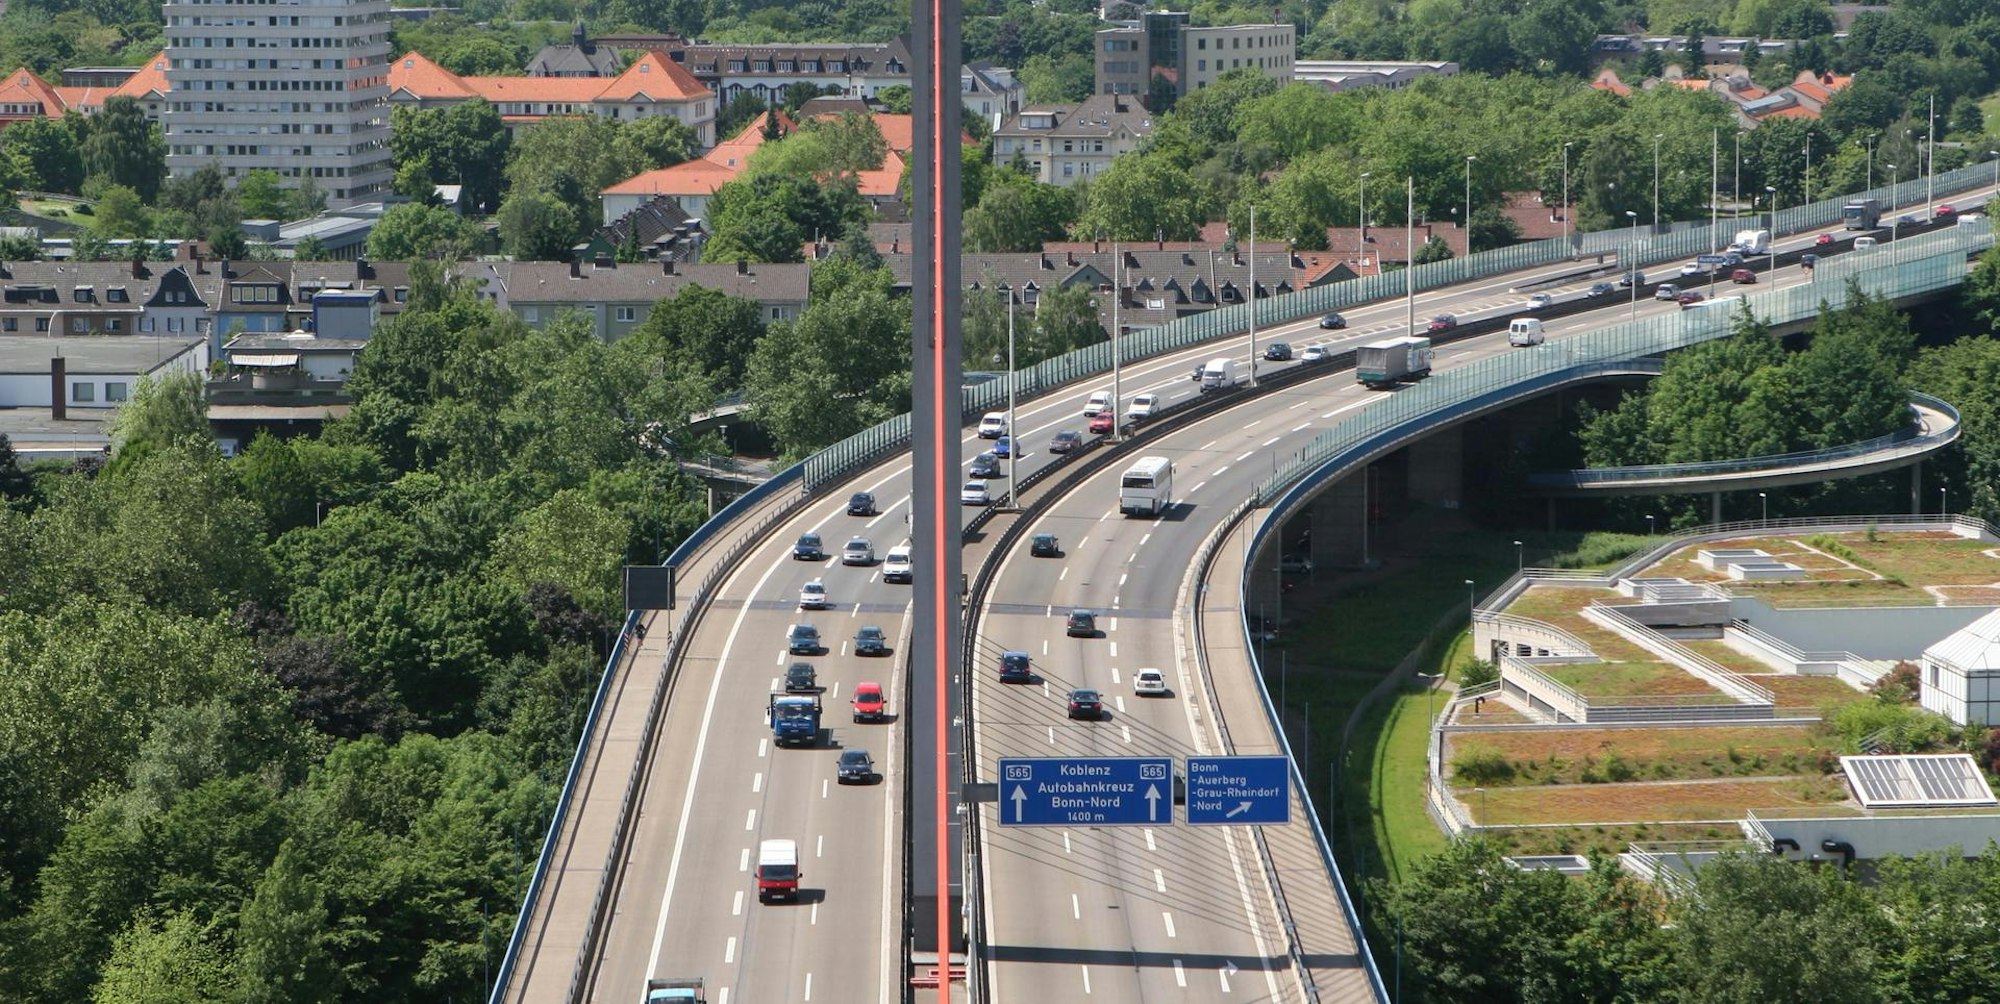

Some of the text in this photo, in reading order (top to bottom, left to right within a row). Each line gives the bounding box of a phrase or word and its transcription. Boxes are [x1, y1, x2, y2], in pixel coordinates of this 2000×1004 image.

[1009, 767, 1029, 778] 565
[1060, 764, 1111, 776] Koblenz
[1143, 766, 1163, 777] 565
[1191, 762, 1219, 772] Bonn
[1038, 782, 1134, 794] Autobahnkreuz
[1052, 797, 1121, 808] Bonn-Nord
[1068, 812, 1105, 822] 1400 m
